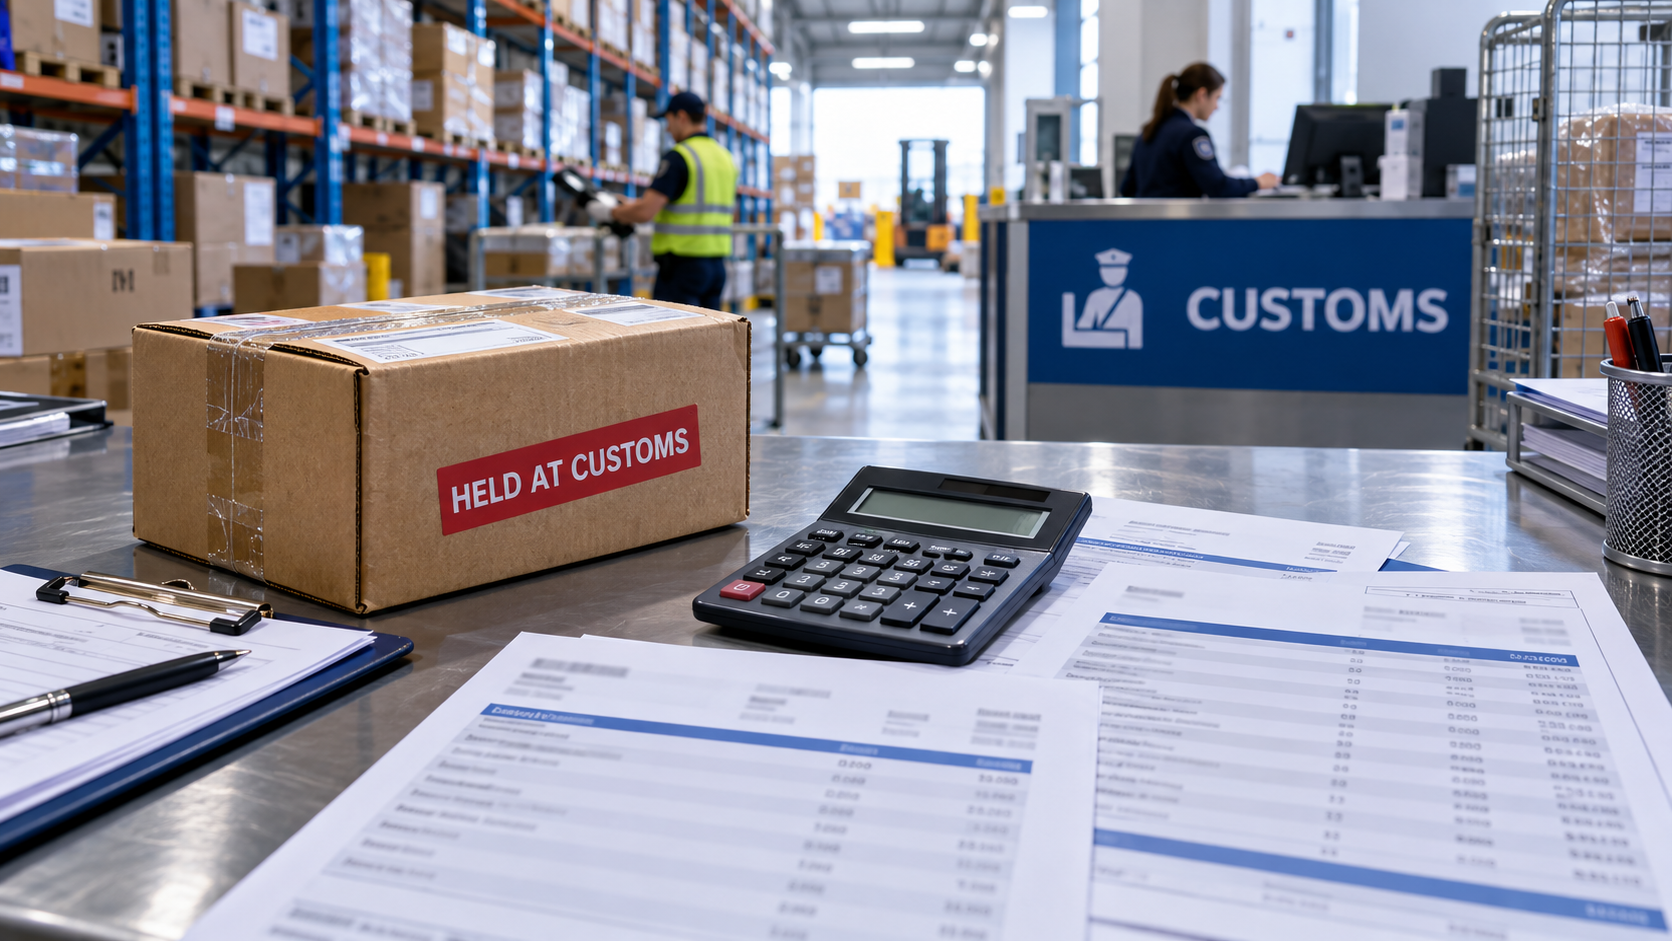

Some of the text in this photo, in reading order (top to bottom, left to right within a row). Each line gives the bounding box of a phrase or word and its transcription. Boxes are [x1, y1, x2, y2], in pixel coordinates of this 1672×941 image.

[1186, 286, 1449, 334] CUSTOMS
[451, 428, 689, 514] HELD AT CUSTOMS
